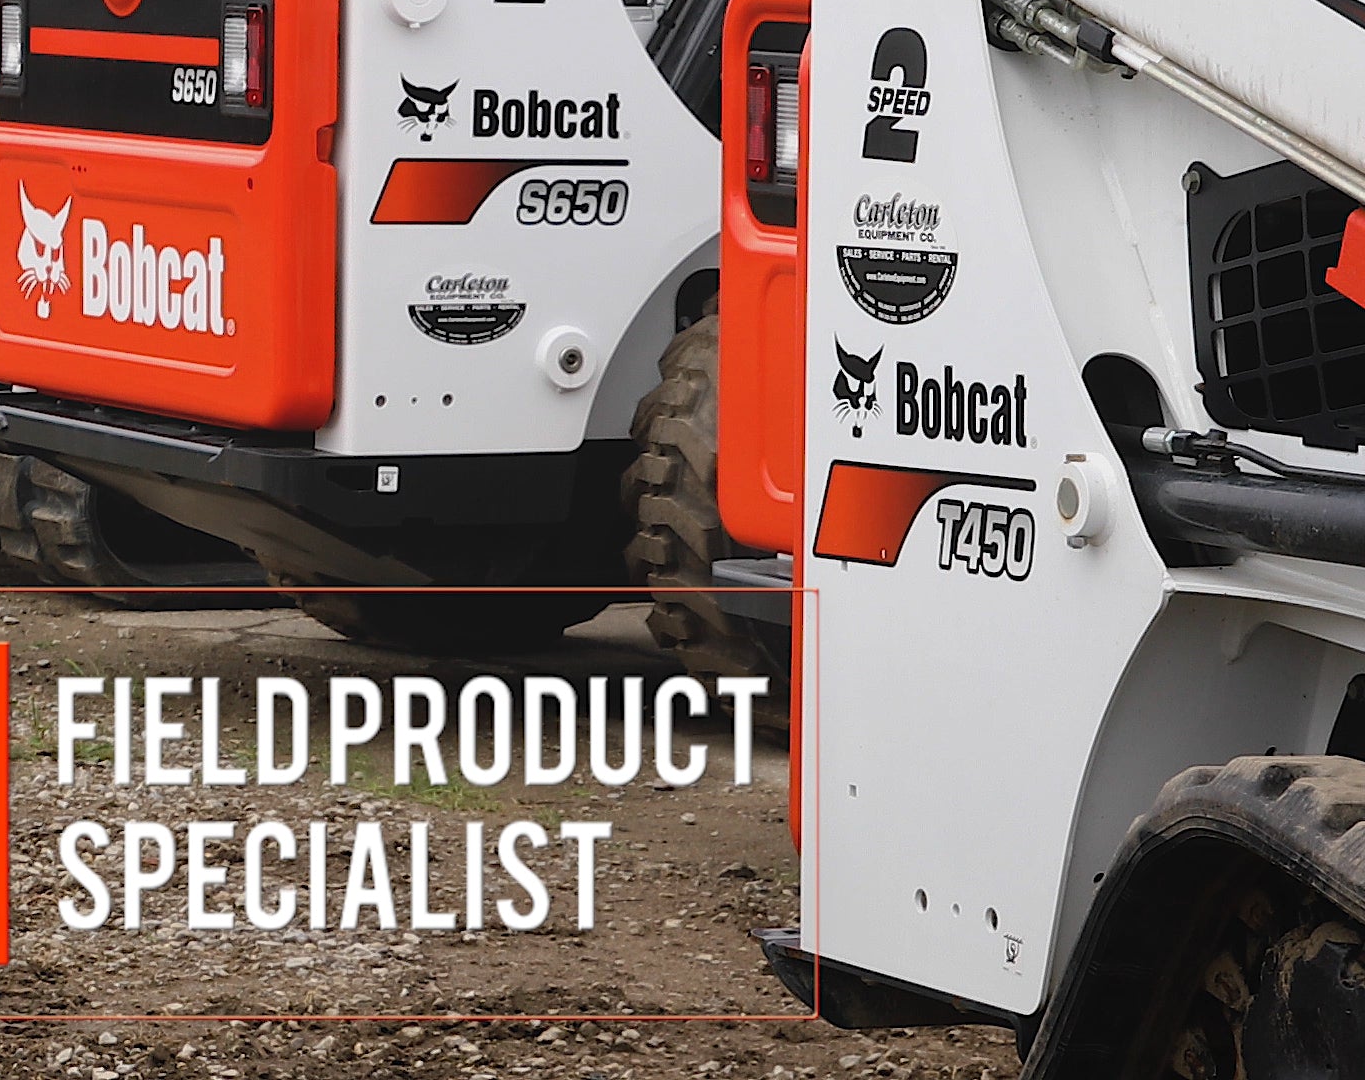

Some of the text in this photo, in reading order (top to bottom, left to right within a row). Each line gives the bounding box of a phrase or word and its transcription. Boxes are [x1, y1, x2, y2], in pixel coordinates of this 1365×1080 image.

[172, 67, 217, 105] S650
[862, 27, 927, 163] 2
[867, 86, 930, 116] SPEED
[473, 89, 620, 139] Bobcat
[516, 179, 629, 226] S650
[854, 192, 941, 230] Carleton
[858, 229, 915, 241] EQUIPMENT
[896, 361, 1027, 448] Bobcat
[936, 498, 1036, 581] T450
